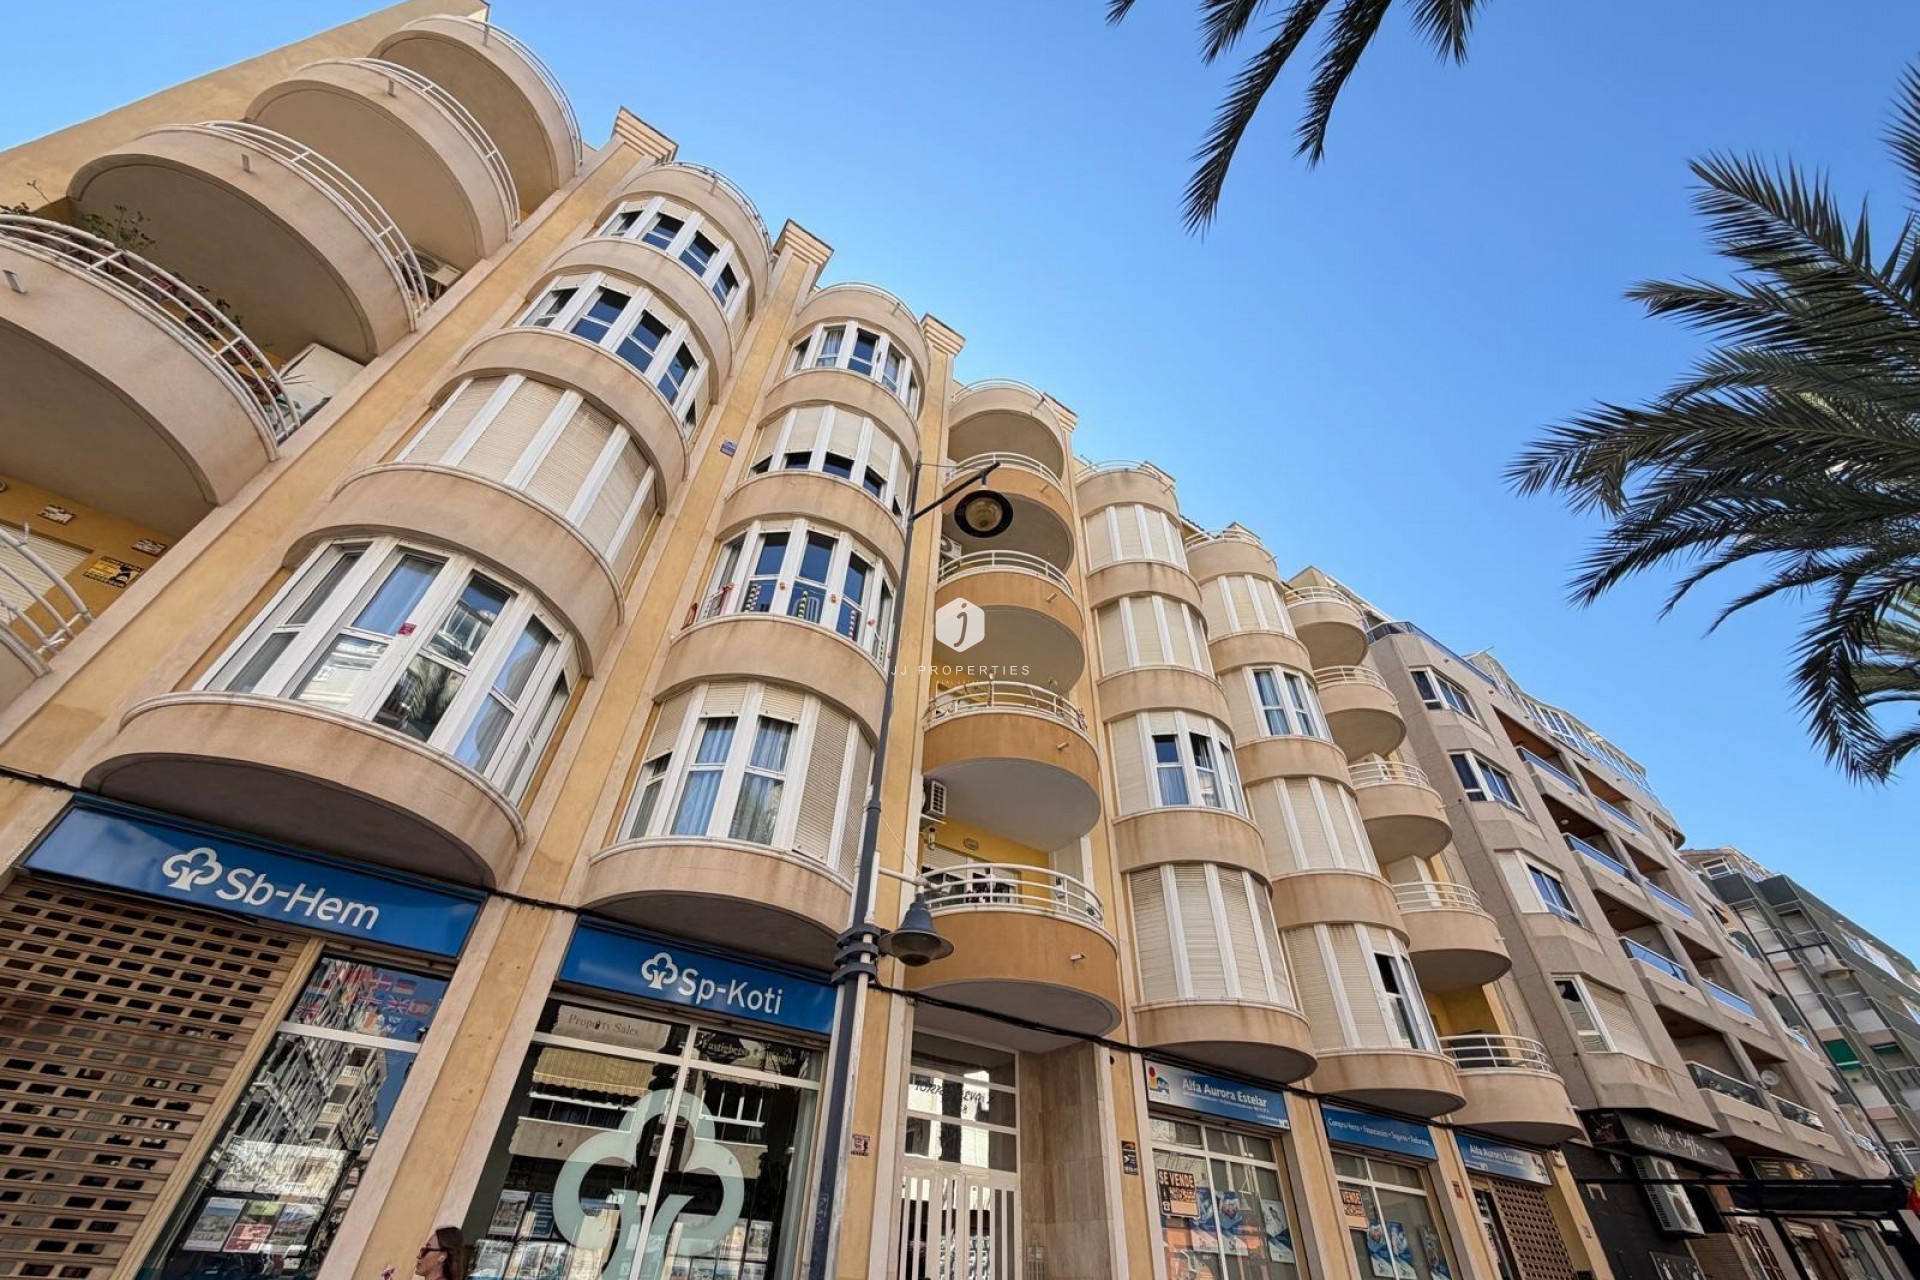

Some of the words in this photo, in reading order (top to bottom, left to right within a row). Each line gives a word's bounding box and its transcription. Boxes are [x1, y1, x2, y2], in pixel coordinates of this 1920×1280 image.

[215, 867, 379, 930] Sb-Hem
[677, 967, 783, 1016] Sp-Koti
[1182, 1078, 1202, 1093] Alfa
[1203, 1083, 1236, 1100] Aurora
[1237, 1090, 1268, 1108] Estelar
[1158, 1170, 1170, 1186] SE
[1169, 1171, 1196, 1189] VENDE
